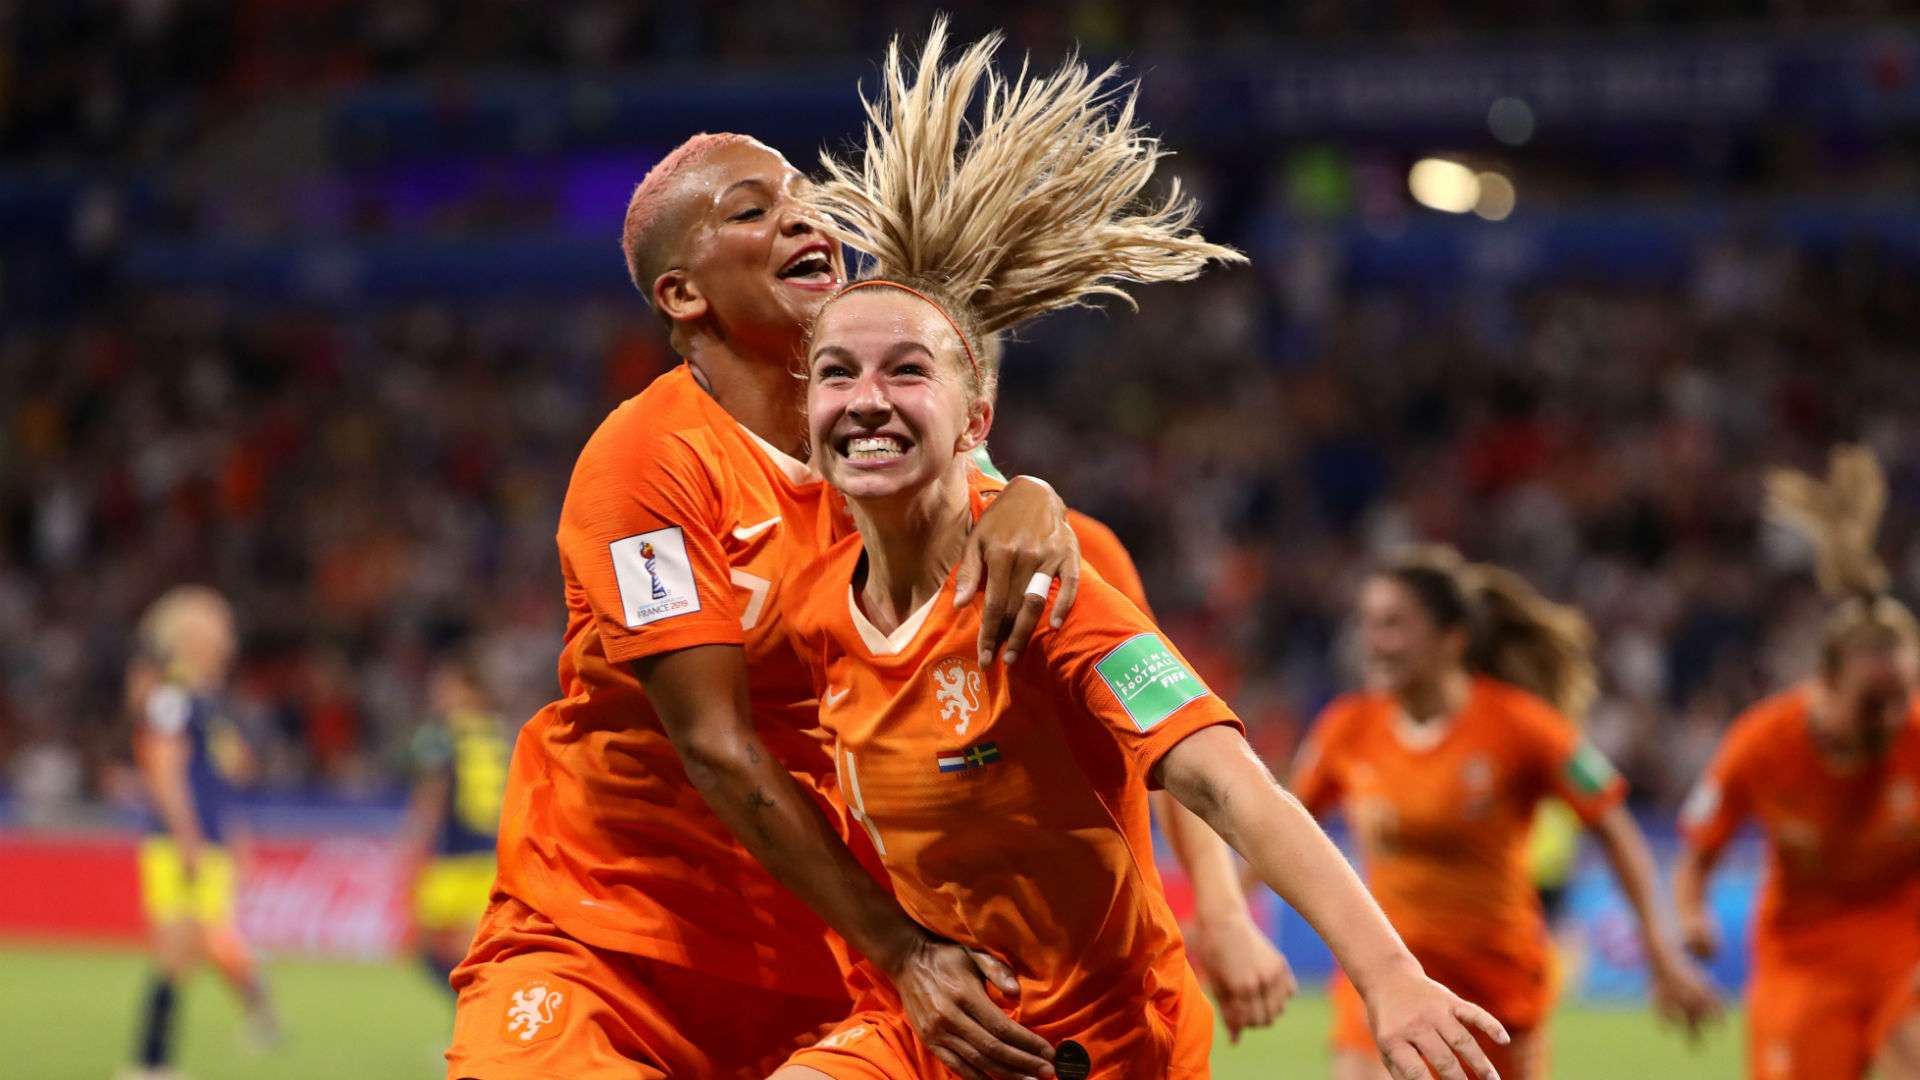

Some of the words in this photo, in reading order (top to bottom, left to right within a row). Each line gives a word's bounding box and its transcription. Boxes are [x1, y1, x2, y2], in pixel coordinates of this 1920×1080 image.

[637, 604, 669, 618] FRANCE
[670, 600, 689, 610] 2019
[729, 568, 772, 631] 7
